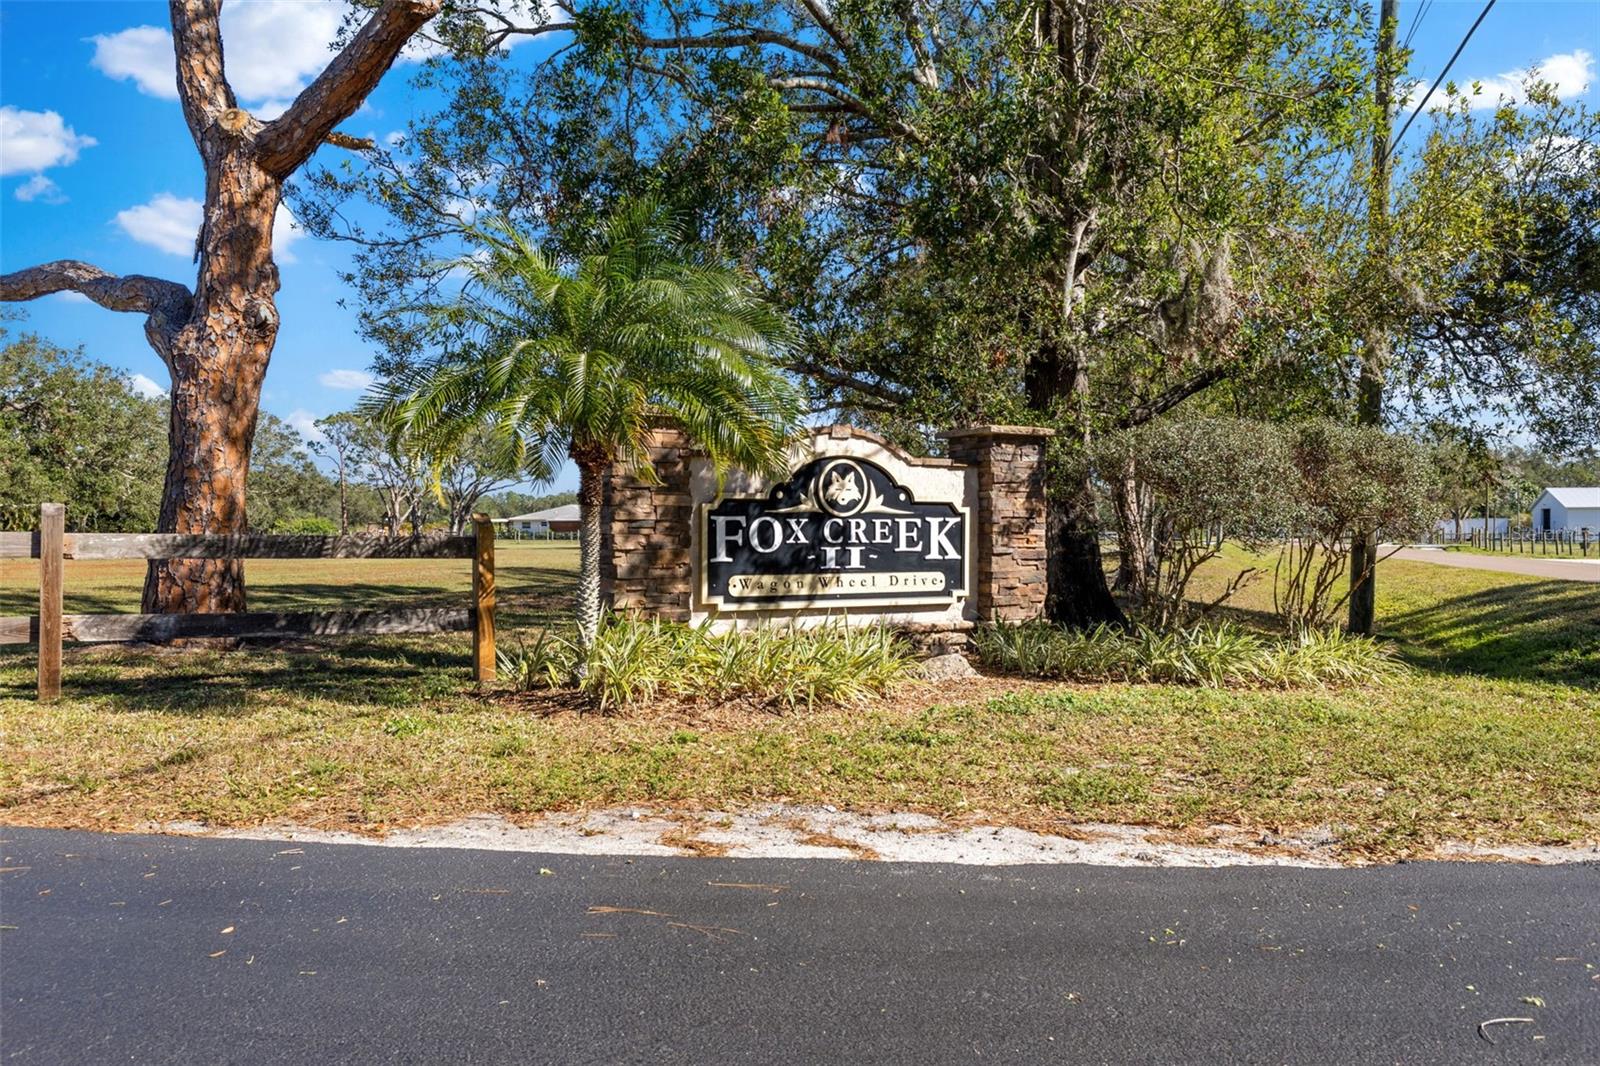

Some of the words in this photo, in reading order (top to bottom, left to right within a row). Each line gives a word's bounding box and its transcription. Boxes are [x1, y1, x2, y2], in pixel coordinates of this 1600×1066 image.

[710, 515, 809, 563] FOX
[823, 516, 962, 560] CREEK
[738, 578, 804, 592] Wagon
[818, 574, 877, 588] Wheel
[889, 573, 938, 587] Drive
